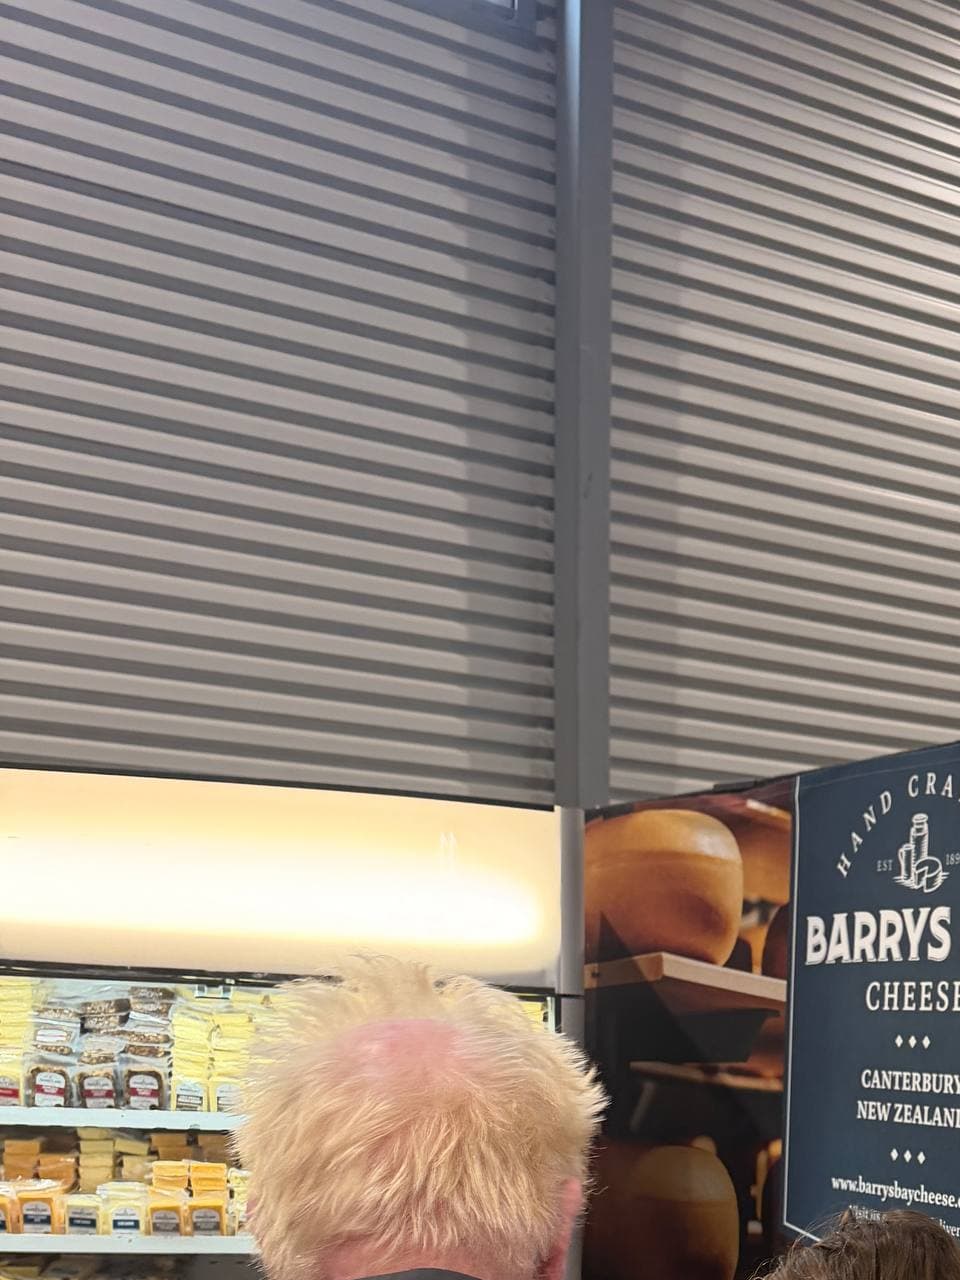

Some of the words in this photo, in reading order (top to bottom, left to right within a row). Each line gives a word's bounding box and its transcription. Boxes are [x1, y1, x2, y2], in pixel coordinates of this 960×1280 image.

[836, 791, 892, 878] HAND
[876, 860, 893, 872] EST
[805, 905, 952, 966] BARRYS
[856, 1100, 893, 1122] NEW
